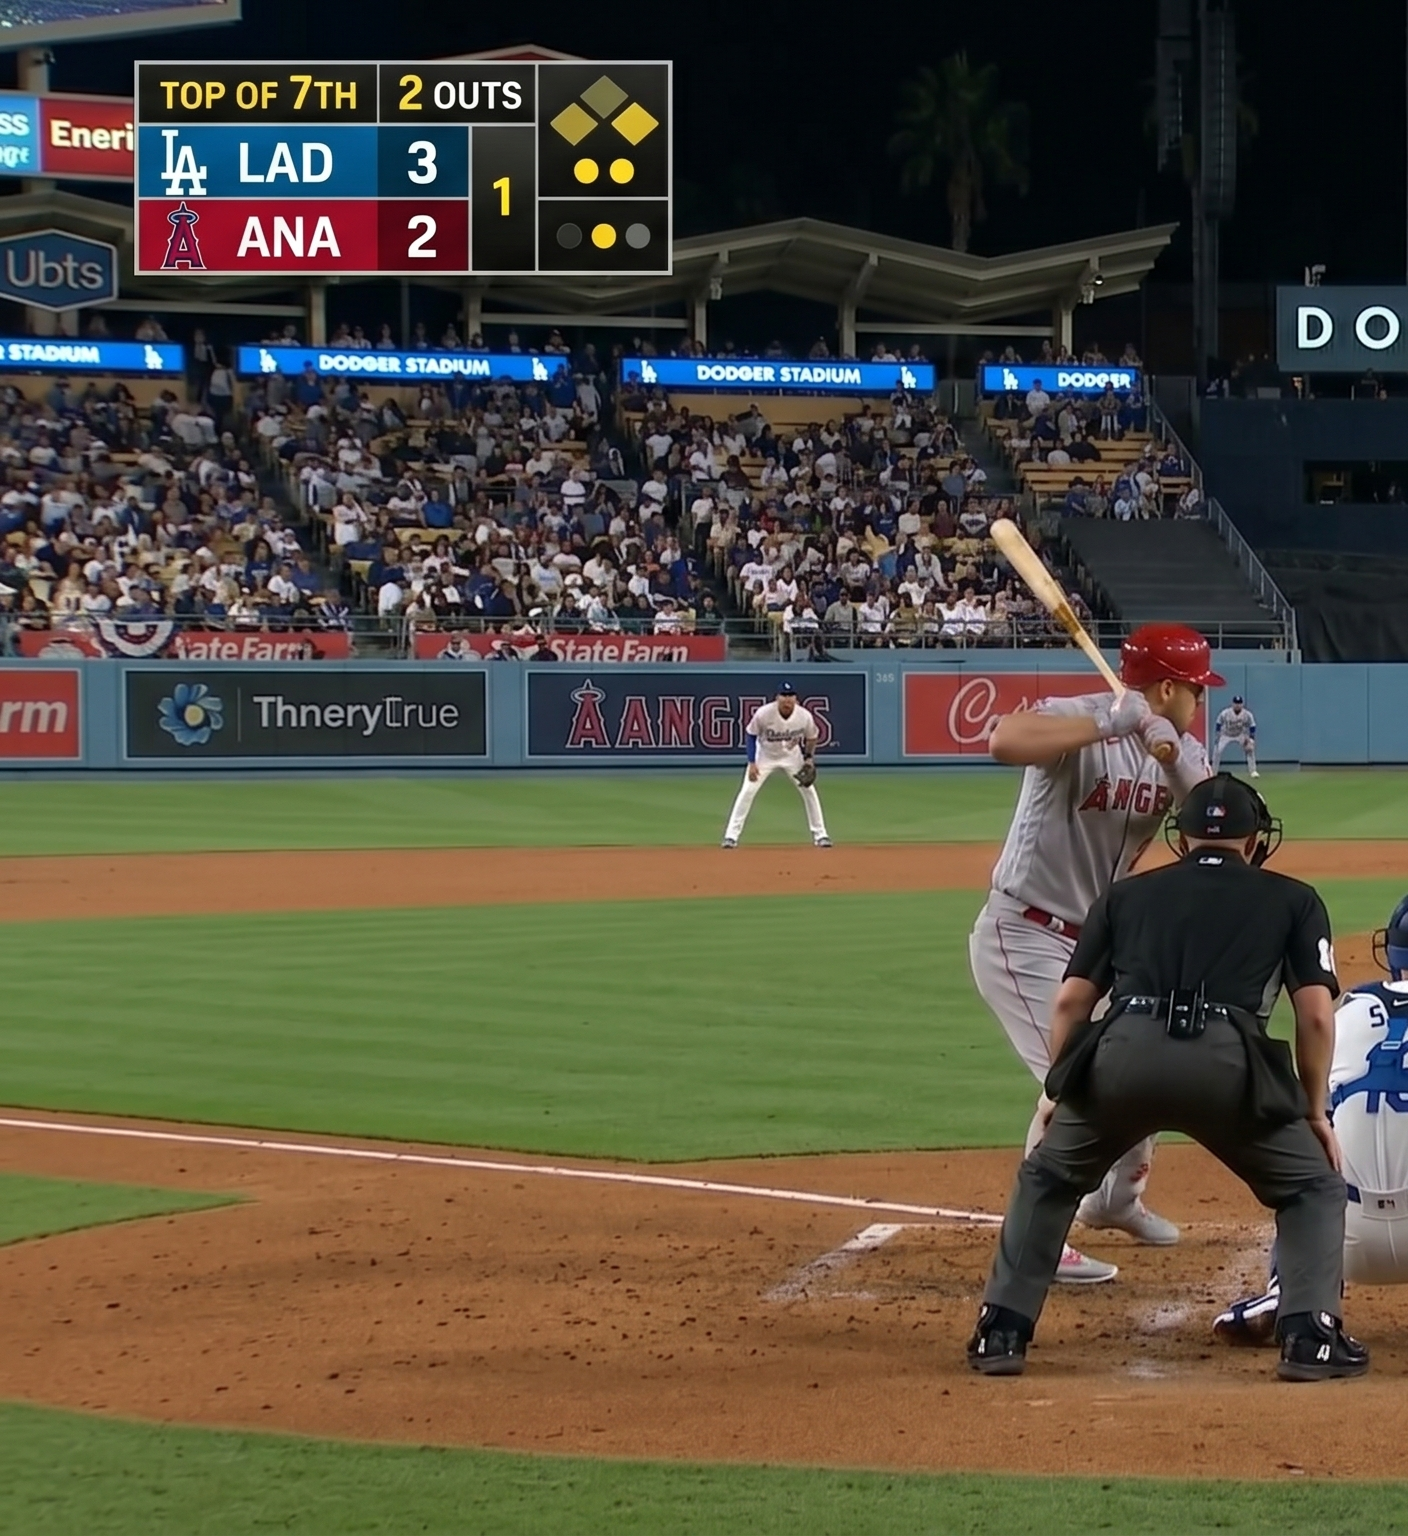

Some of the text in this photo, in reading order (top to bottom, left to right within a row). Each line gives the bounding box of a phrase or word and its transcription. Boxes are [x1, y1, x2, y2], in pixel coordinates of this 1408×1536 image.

[7, 249, 104, 290] Ubts
[9, 343, 101, 364] STADIUM
[319, 354, 402, 373] DODGER
[405, 357, 491, 376] STADIUM
[697, 364, 776, 383] DODGER
[780, 367, 862, 384] STADIUM
[551, 639, 619, 663] State
[614, 696, 832, 748] ANGS
